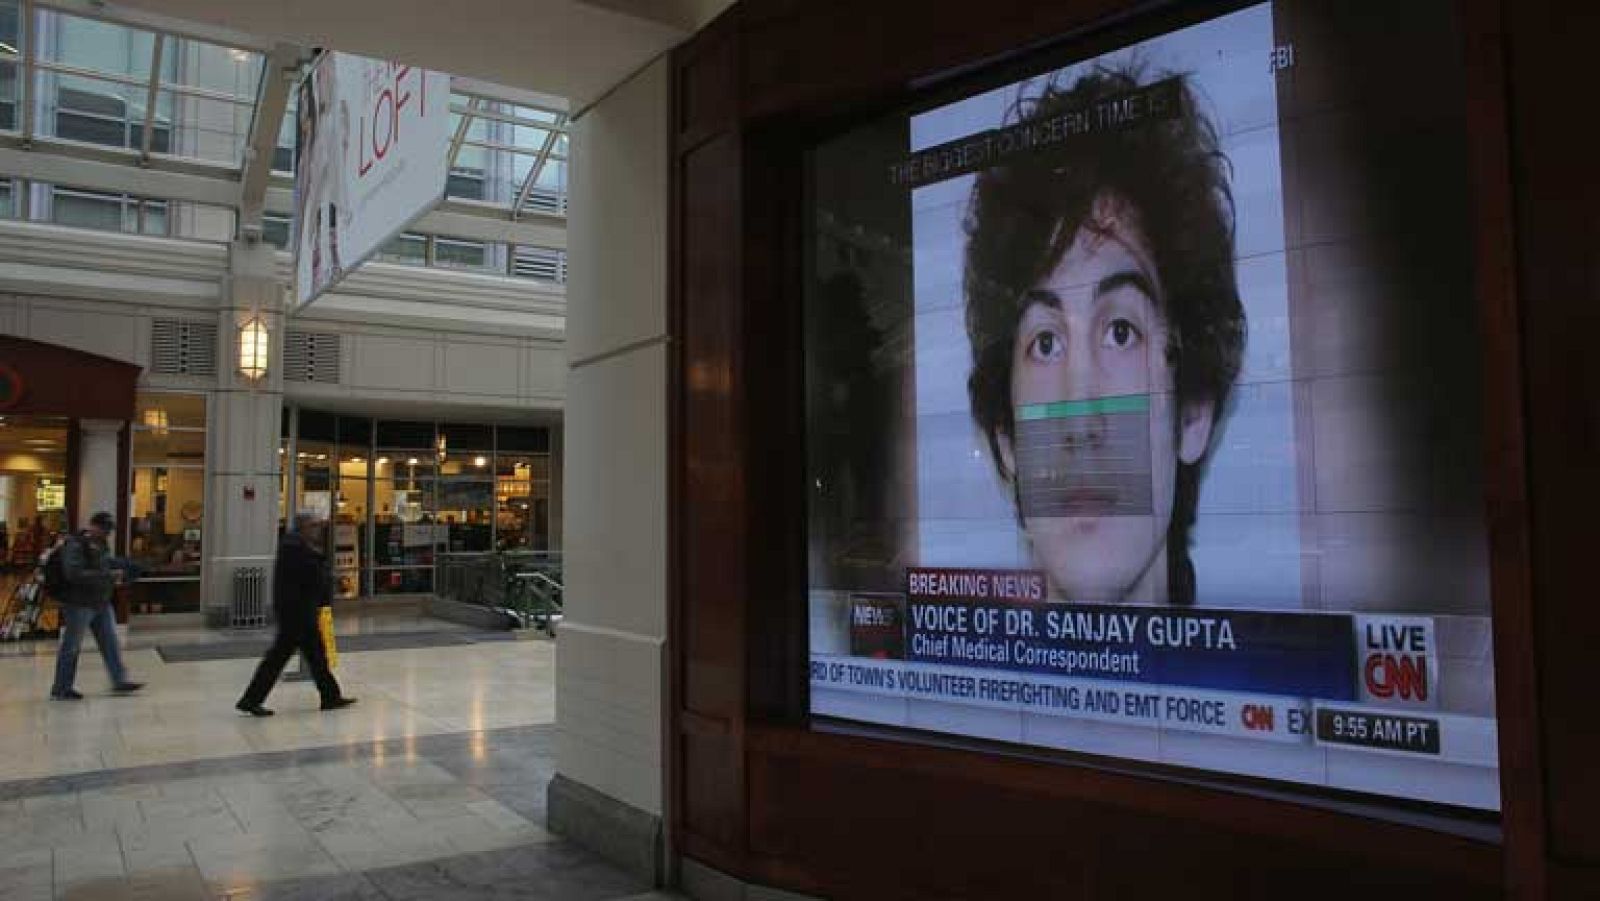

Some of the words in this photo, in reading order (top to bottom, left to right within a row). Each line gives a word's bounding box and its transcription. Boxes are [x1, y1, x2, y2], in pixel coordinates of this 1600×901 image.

[1101, 97, 1144, 134] TIME
[909, 572, 988, 597] BREAKING
[993, 575, 1042, 600] NEWS
[911, 604, 968, 633] VOICE
[974, 607, 999, 635] OF
[1005, 608, 1040, 637] DR.
[1047, 610, 1139, 644] SANJAY
[1147, 615, 1237, 650] GUPTA
[1366, 623, 1426, 651] LIVE
[911, 632, 949, 657] Chief
[952, 635, 1009, 663] Medical
[1014, 639, 1140, 674] Correspondent
[1364, 653, 1428, 701] CNN
[830, 662, 846, 683] OF
[848, 664, 895, 689] TOWN'S
[897, 669, 975, 699] VOLUNTEER
[979, 678, 1080, 710] FIREFIGHTING
[1085, 687, 1120, 714] AND
[1124, 691, 1161, 719] EMT
[1166, 696, 1226, 727] FORCE
[1241, 703, 1275, 732] CNN
[1332, 714, 1368, 738] 9:55
[1373, 718, 1401, 743] AM
[1406, 721, 1429, 746] PT
